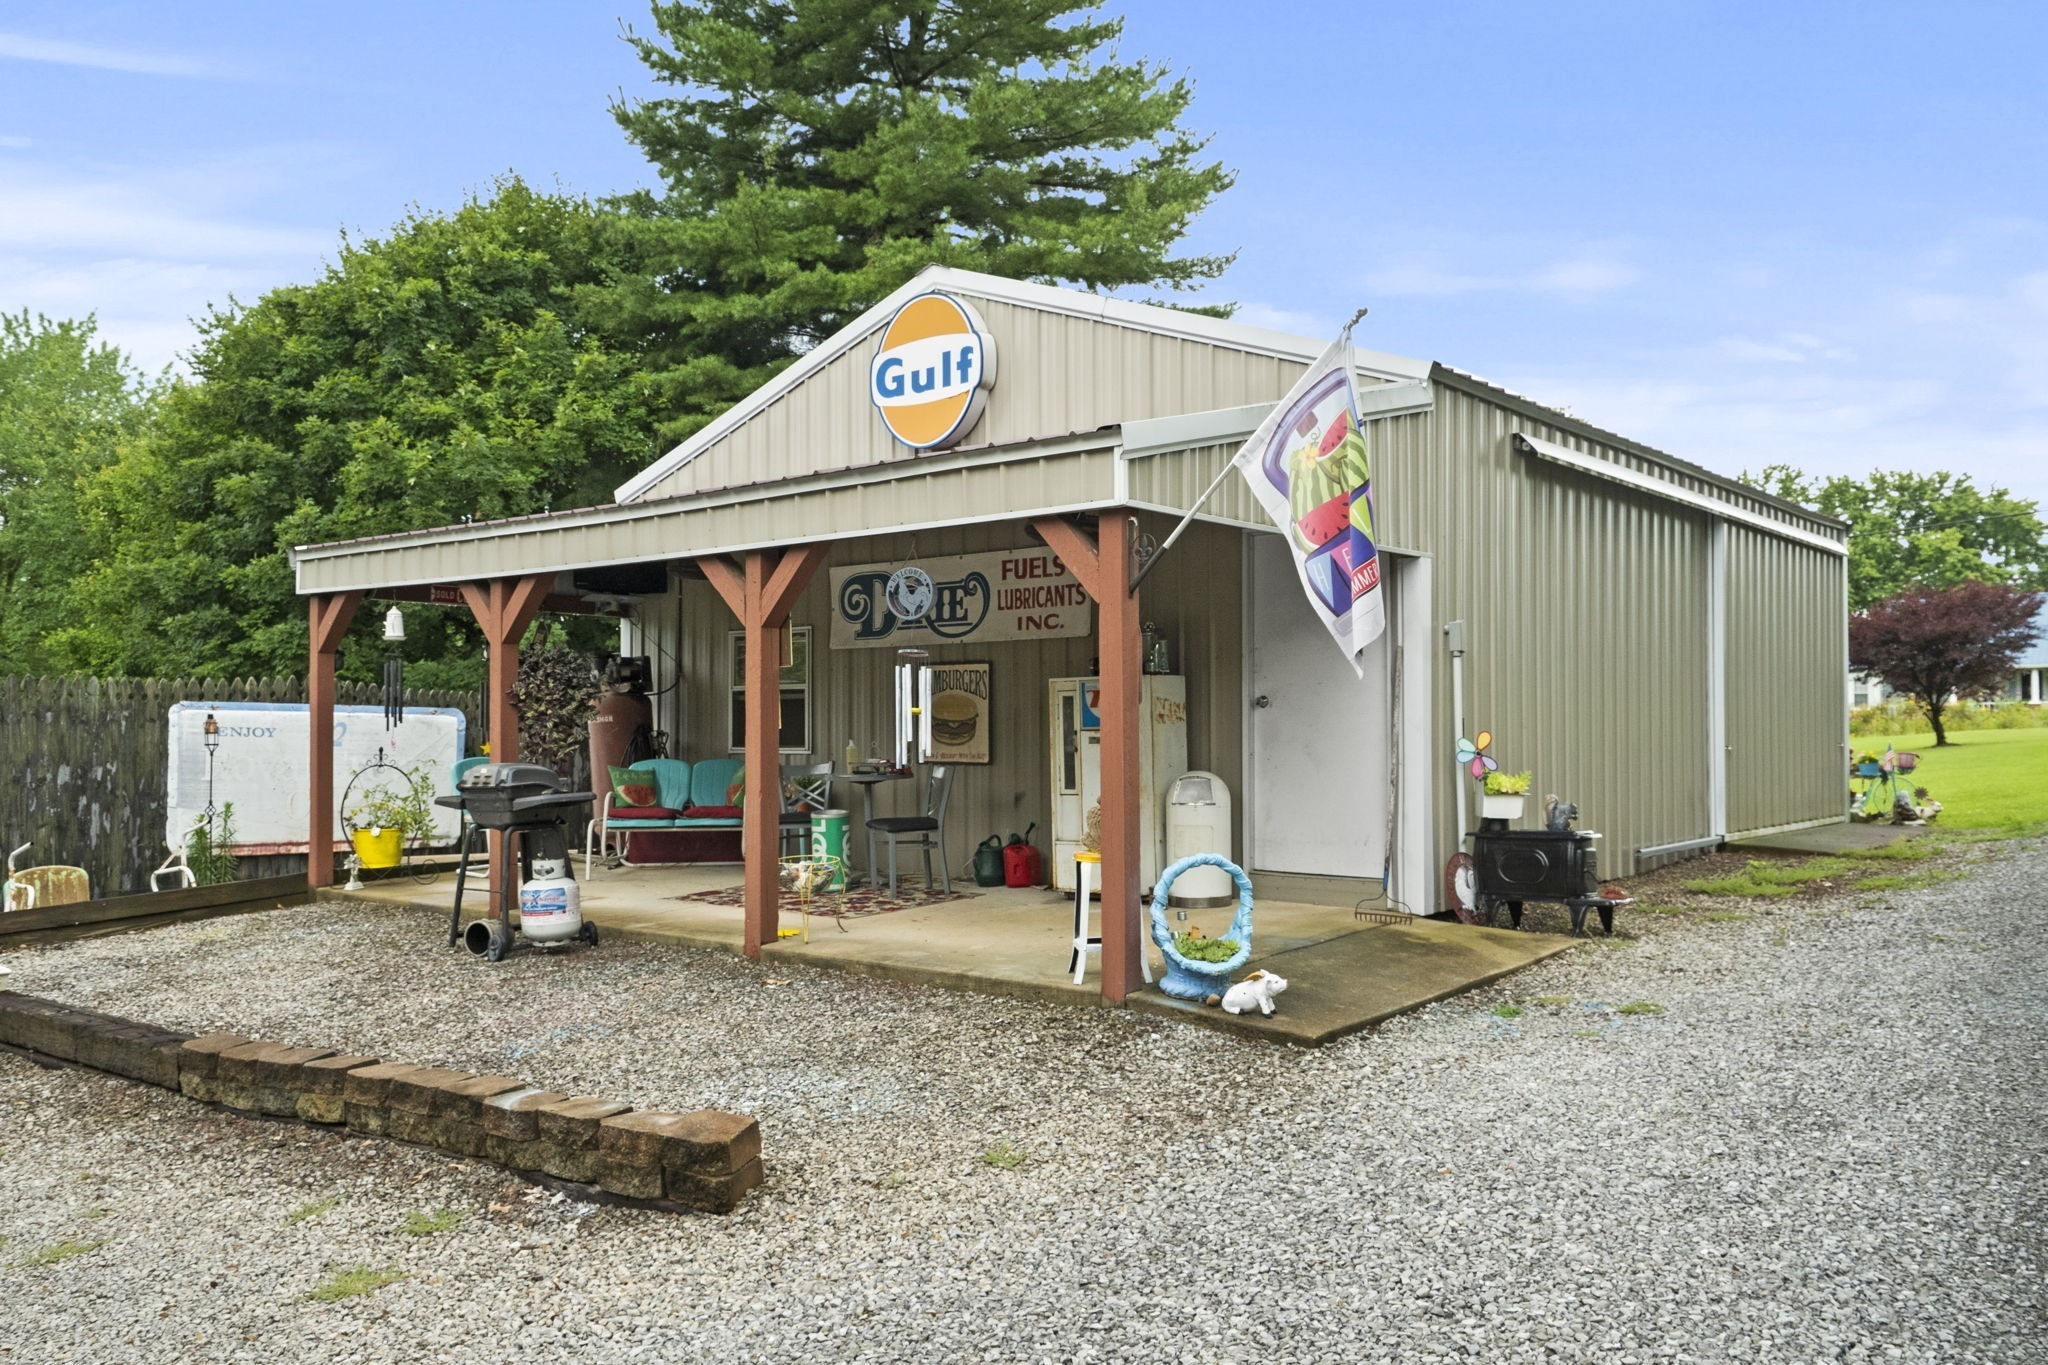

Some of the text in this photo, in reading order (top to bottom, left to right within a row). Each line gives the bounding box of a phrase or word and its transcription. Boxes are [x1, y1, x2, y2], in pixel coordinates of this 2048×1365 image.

[876, 346, 974, 398] Gulf
[891, 568, 924, 583] WELCOME
[1001, 554, 1066, 581] FUELS
[997, 582, 1087, 611] LUBRICANTS
[1017, 613, 1065, 631] INC.
[931, 669, 988, 700] MBURGERS
[217, 726, 277, 738] ENJOY
